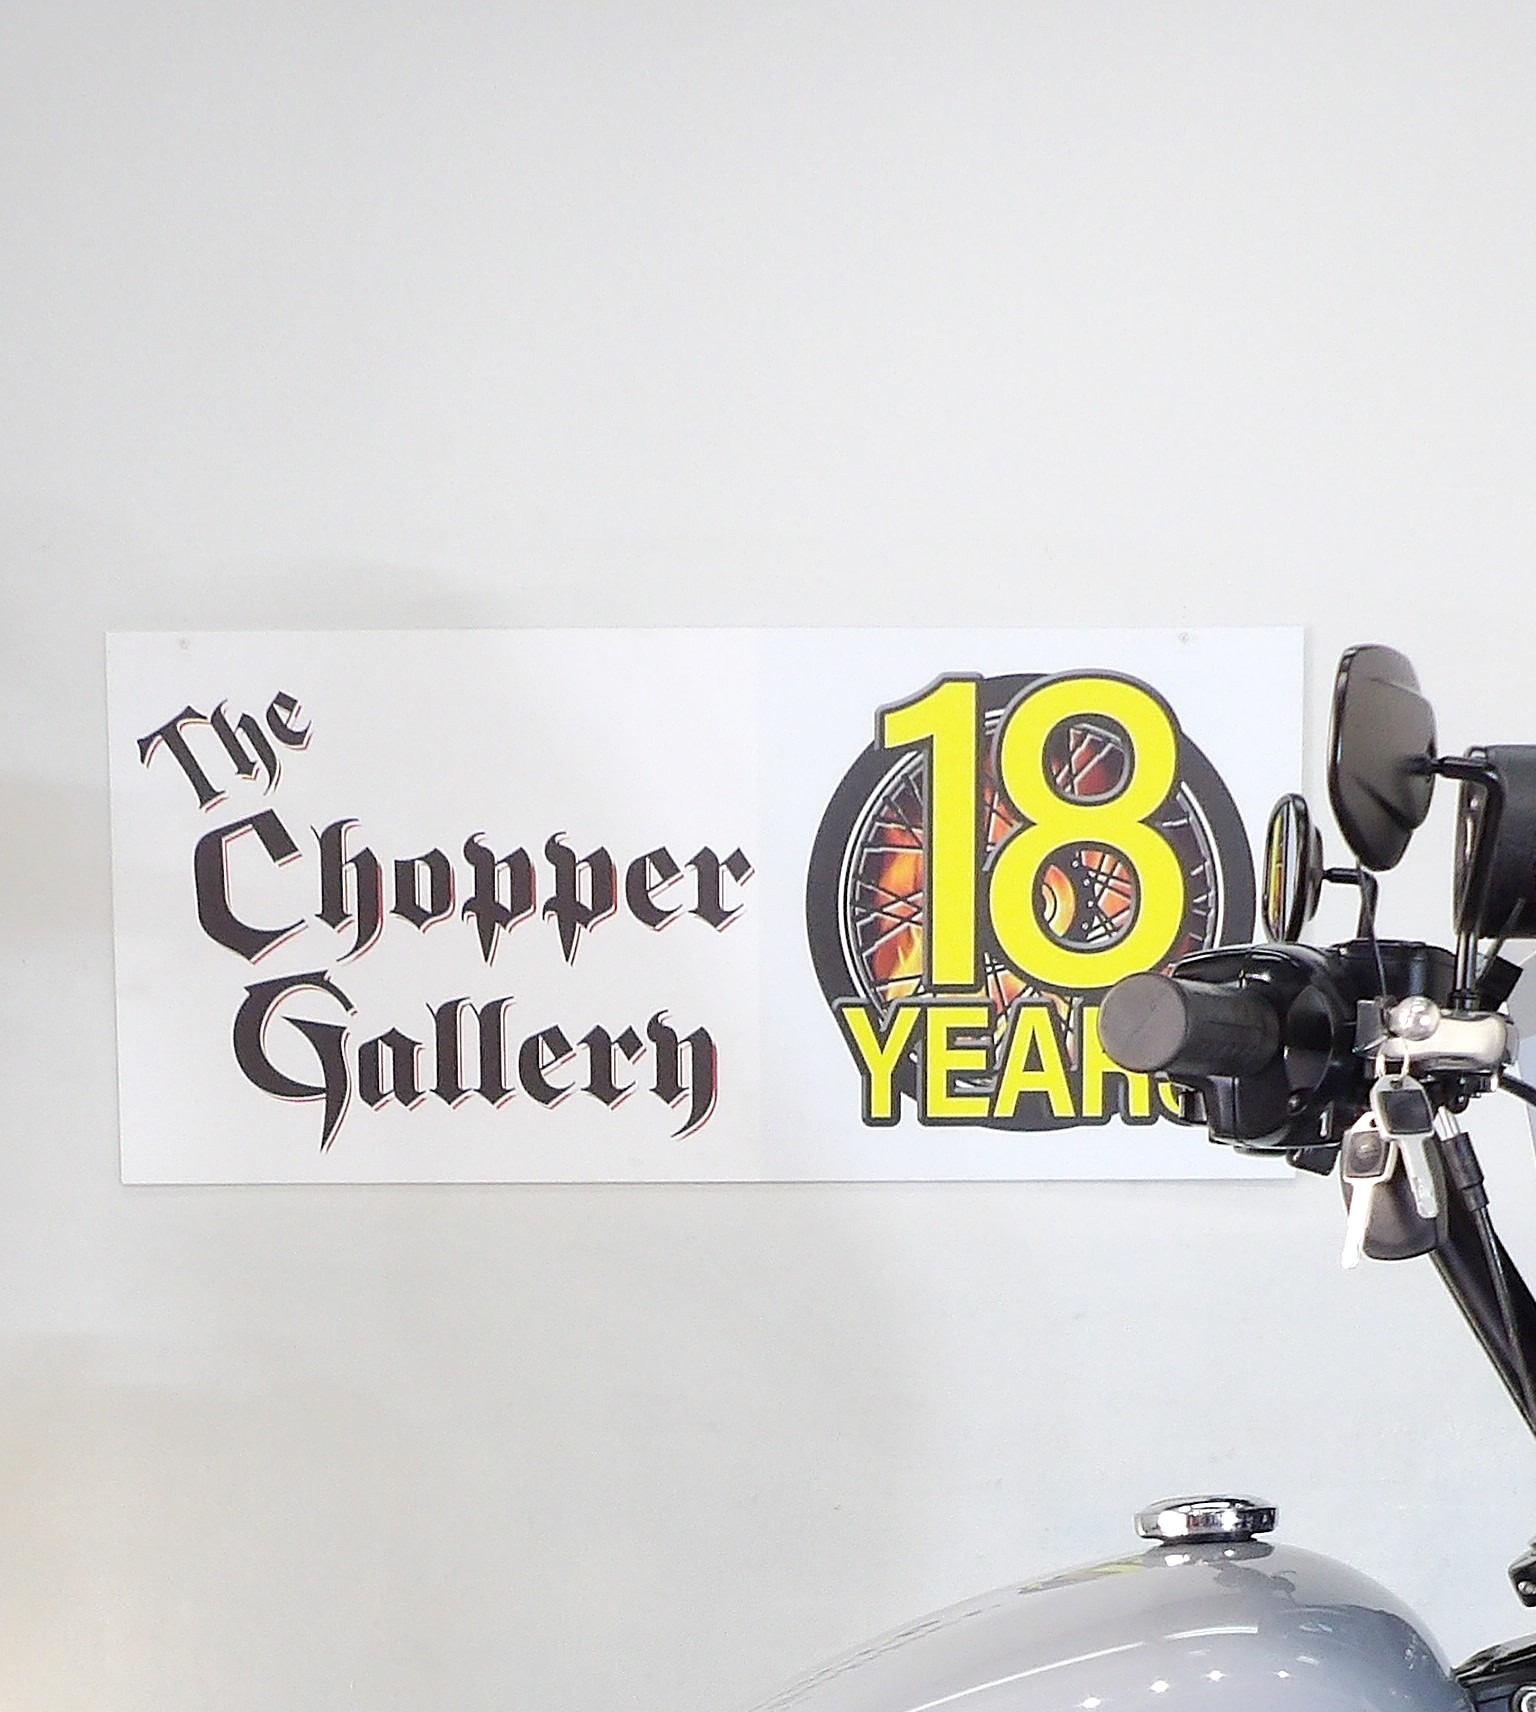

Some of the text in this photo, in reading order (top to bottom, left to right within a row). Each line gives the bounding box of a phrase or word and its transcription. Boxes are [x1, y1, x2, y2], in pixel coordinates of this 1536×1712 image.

[137, 687, 314, 811] The
[193, 806, 754, 965] Chopper
[878, 672, 1188, 992] 18
[232, 969, 721, 1152] Gallery
[840, 1003, 1184, 1119] YEAR
